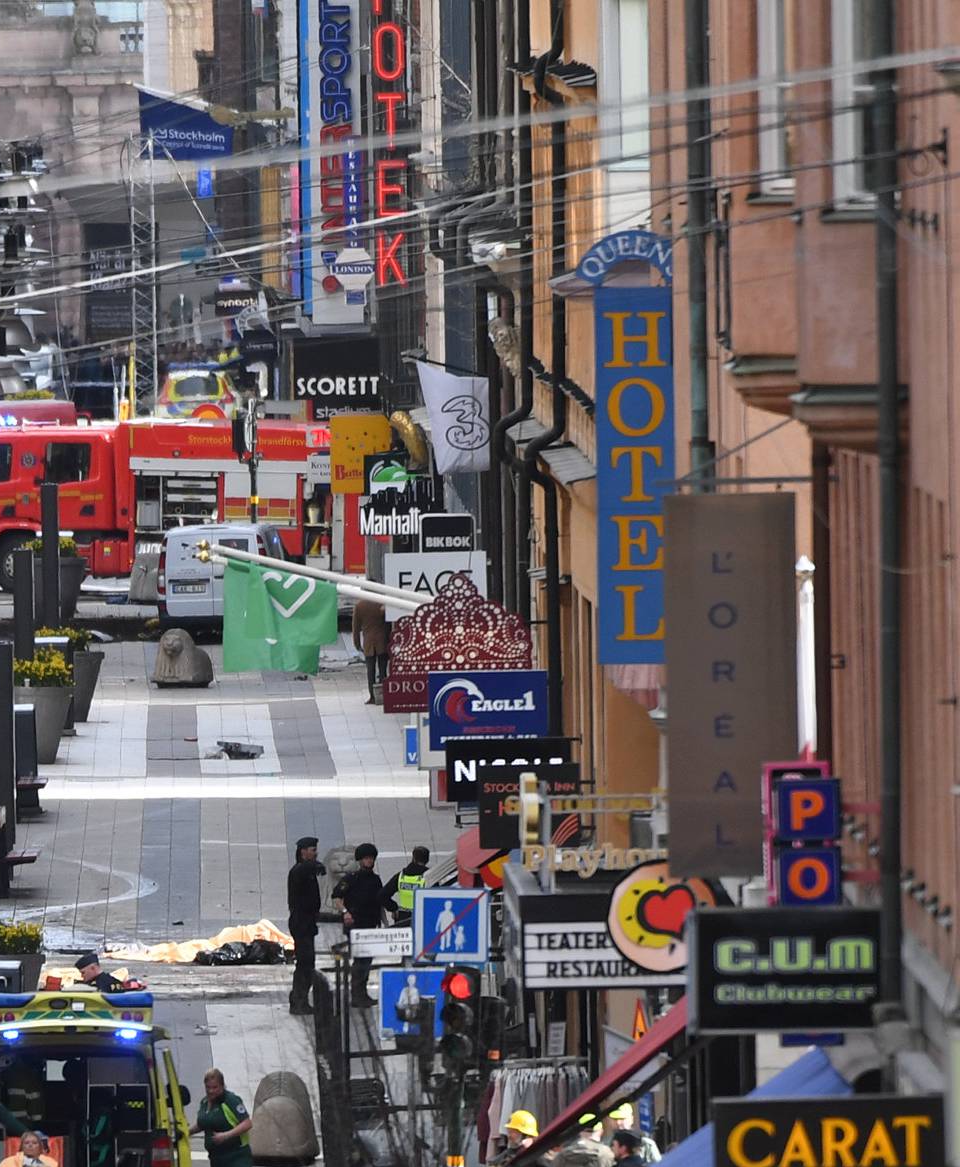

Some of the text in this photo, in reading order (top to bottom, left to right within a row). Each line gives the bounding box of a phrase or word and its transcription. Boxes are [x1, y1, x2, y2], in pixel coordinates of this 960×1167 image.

[168, 128, 225, 143] Stockholm
[372, 0, 408, 288] OTEK
[335, 263, 374, 274] LONDON
[297, 376, 380, 396] SCORETT
[602, 311, 666, 641] HOTEL
[425, 535, 471, 548] BIK BOK
[398, 570, 473, 591] FAC
[388, 681, 428, 693] DRO
[535, 933, 609, 950] TEATER
